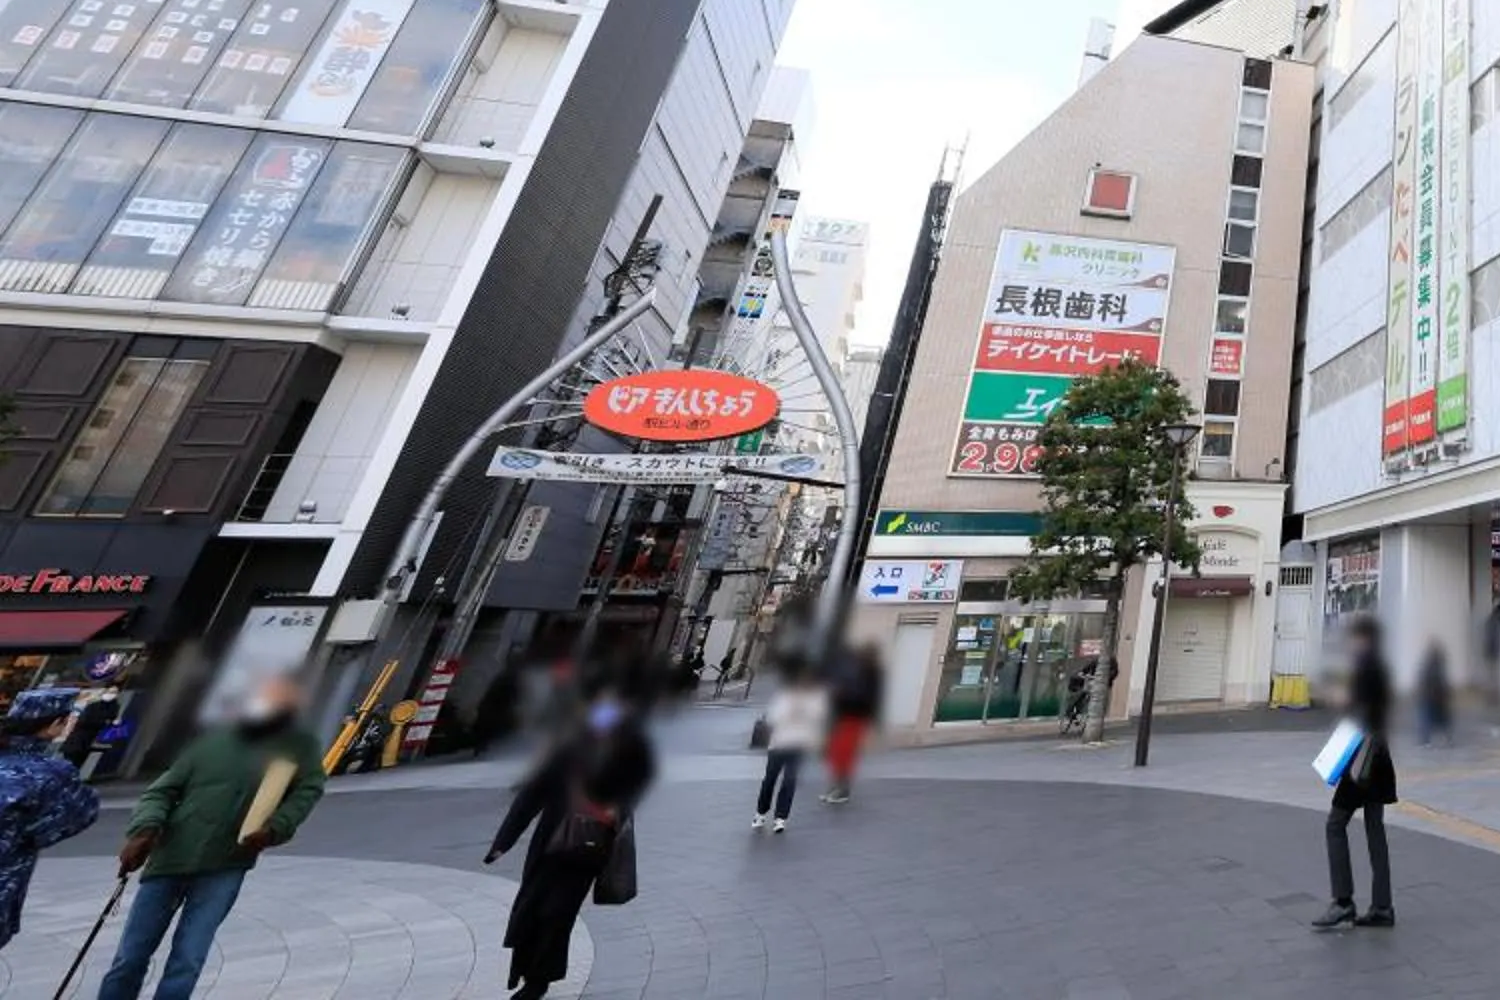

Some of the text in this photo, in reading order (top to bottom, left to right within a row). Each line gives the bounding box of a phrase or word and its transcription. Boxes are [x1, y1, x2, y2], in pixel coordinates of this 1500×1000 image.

[993, 285, 1129, 324] 長根歯科
[904, 520, 942, 535] SMBC
[30, 568, 150, 593] FRANCE
[873, 566, 904, 580] 入口
